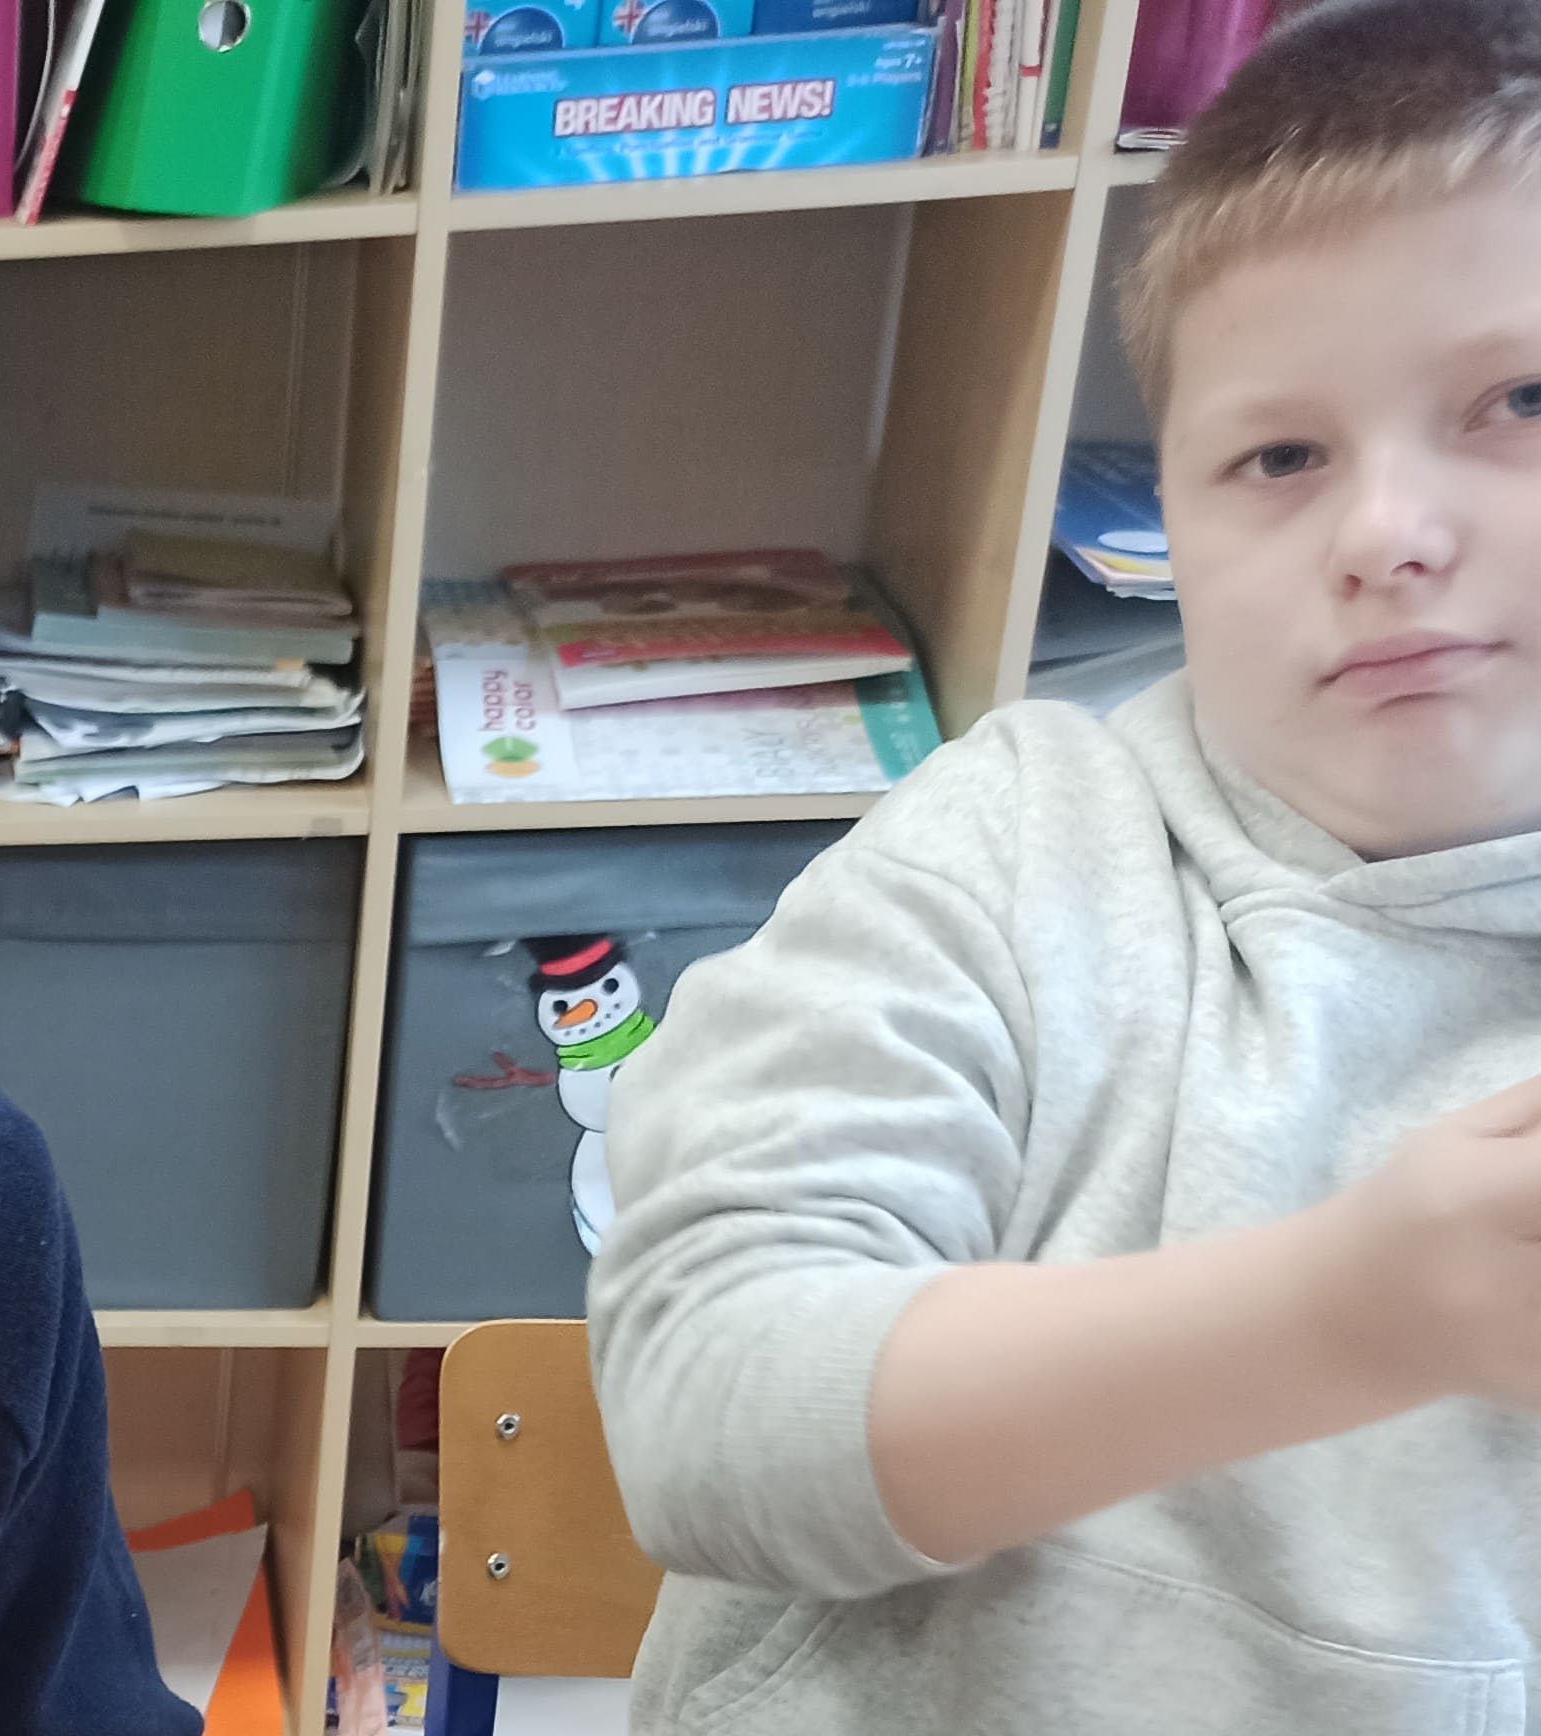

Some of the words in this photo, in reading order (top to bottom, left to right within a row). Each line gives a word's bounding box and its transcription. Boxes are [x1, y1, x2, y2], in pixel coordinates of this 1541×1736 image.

[554, 89, 715, 137] BREAKING
[726, 79, 835, 124] NEWS!
[477, 670, 510, 732] happy
[514, 681, 536, 731] color
